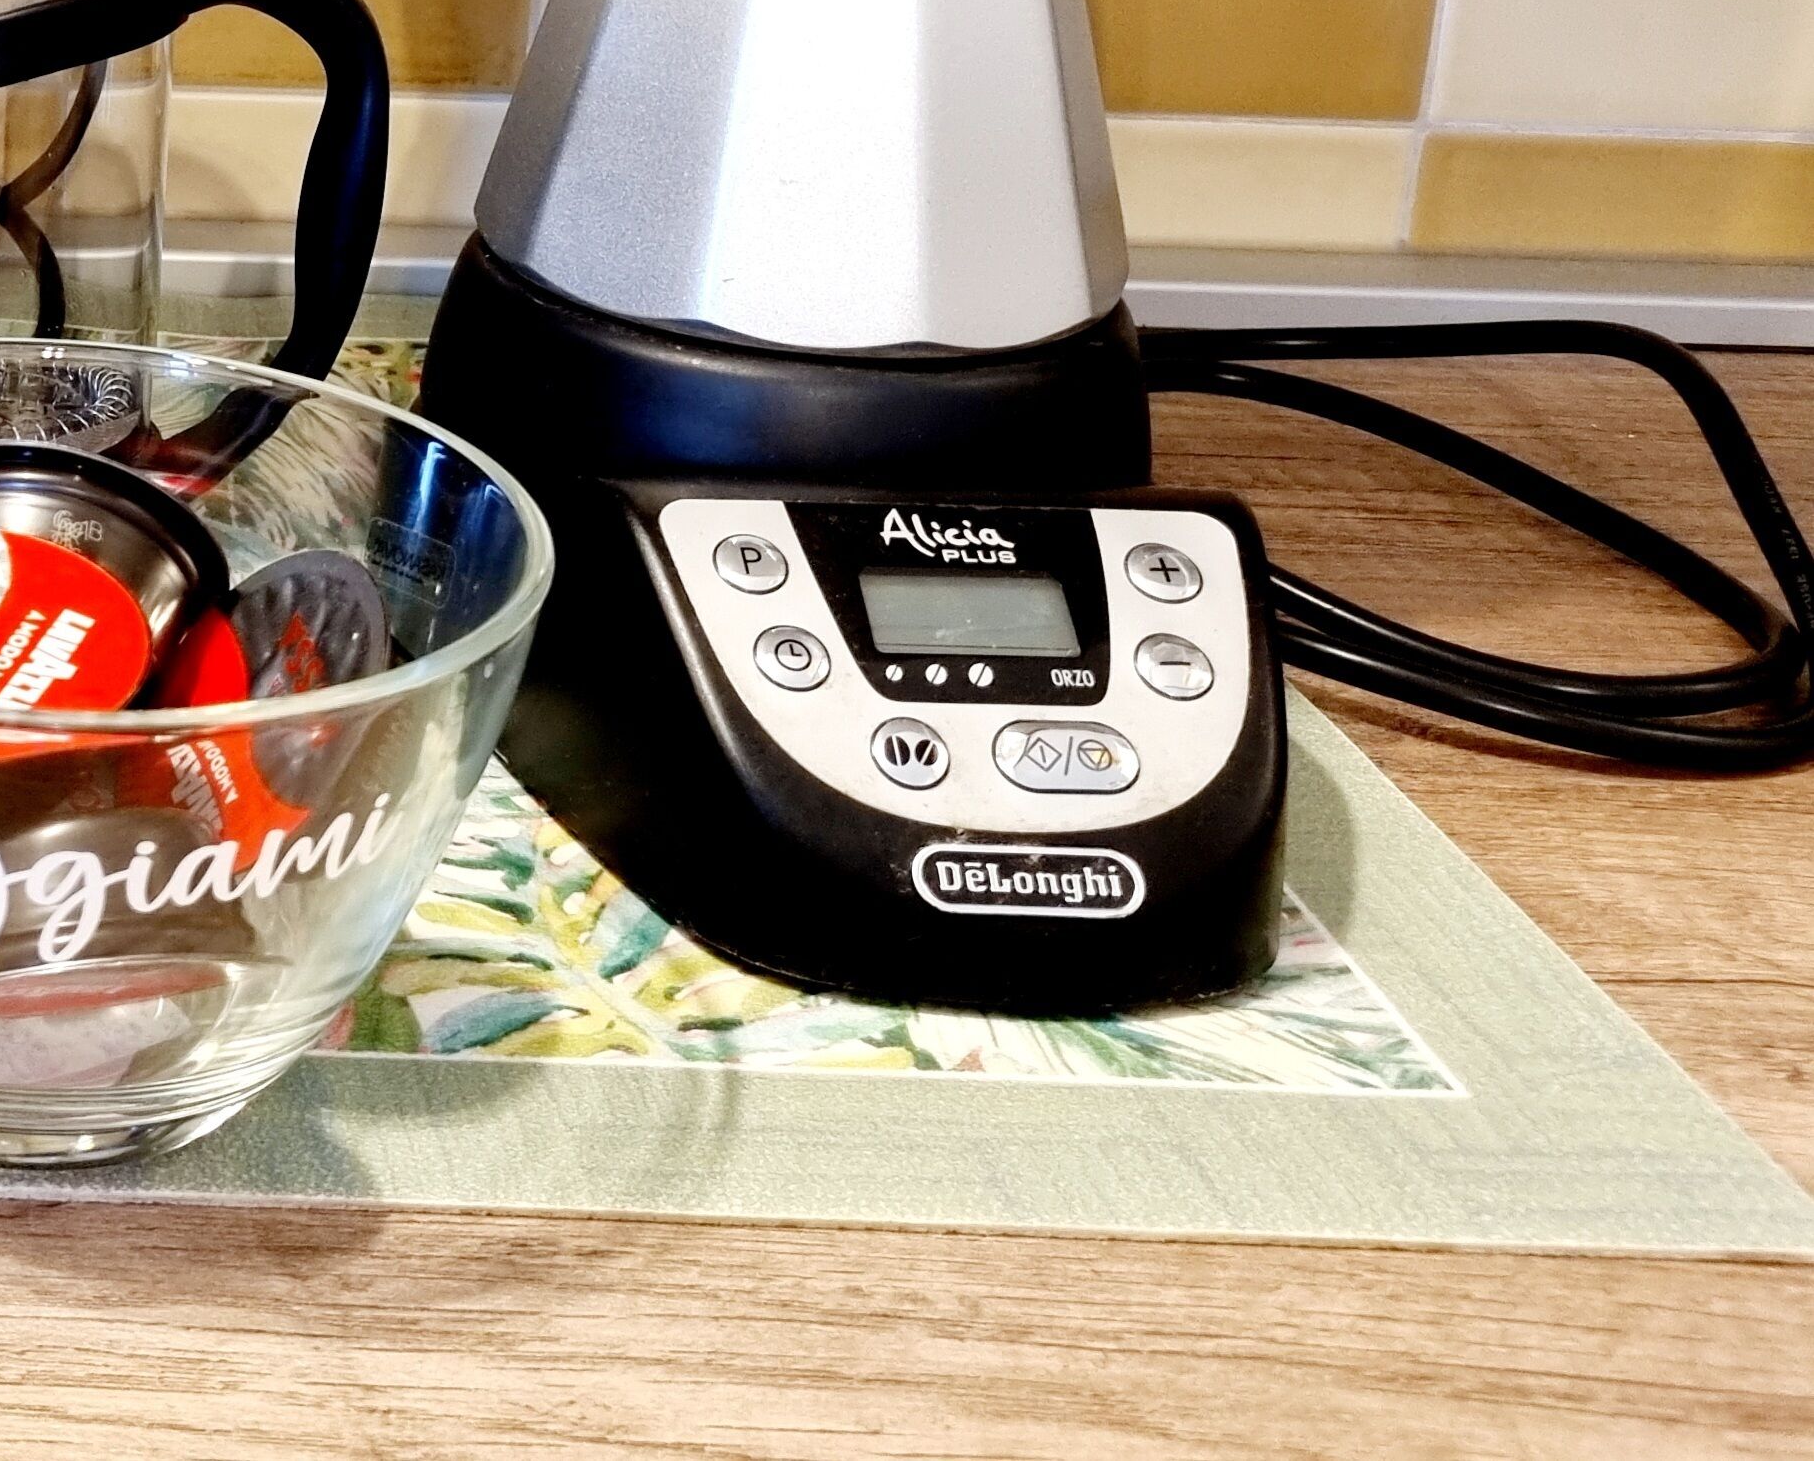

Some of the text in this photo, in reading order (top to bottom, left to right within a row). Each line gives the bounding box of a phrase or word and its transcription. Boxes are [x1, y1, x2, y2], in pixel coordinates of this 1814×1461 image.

[879, 507, 1015, 557] Alicia
[740, 547, 762, 575] P
[941, 548, 1017, 564] PLUS
[24, 608, 48, 622] A
[1050, 668, 1096, 688] ORZO
